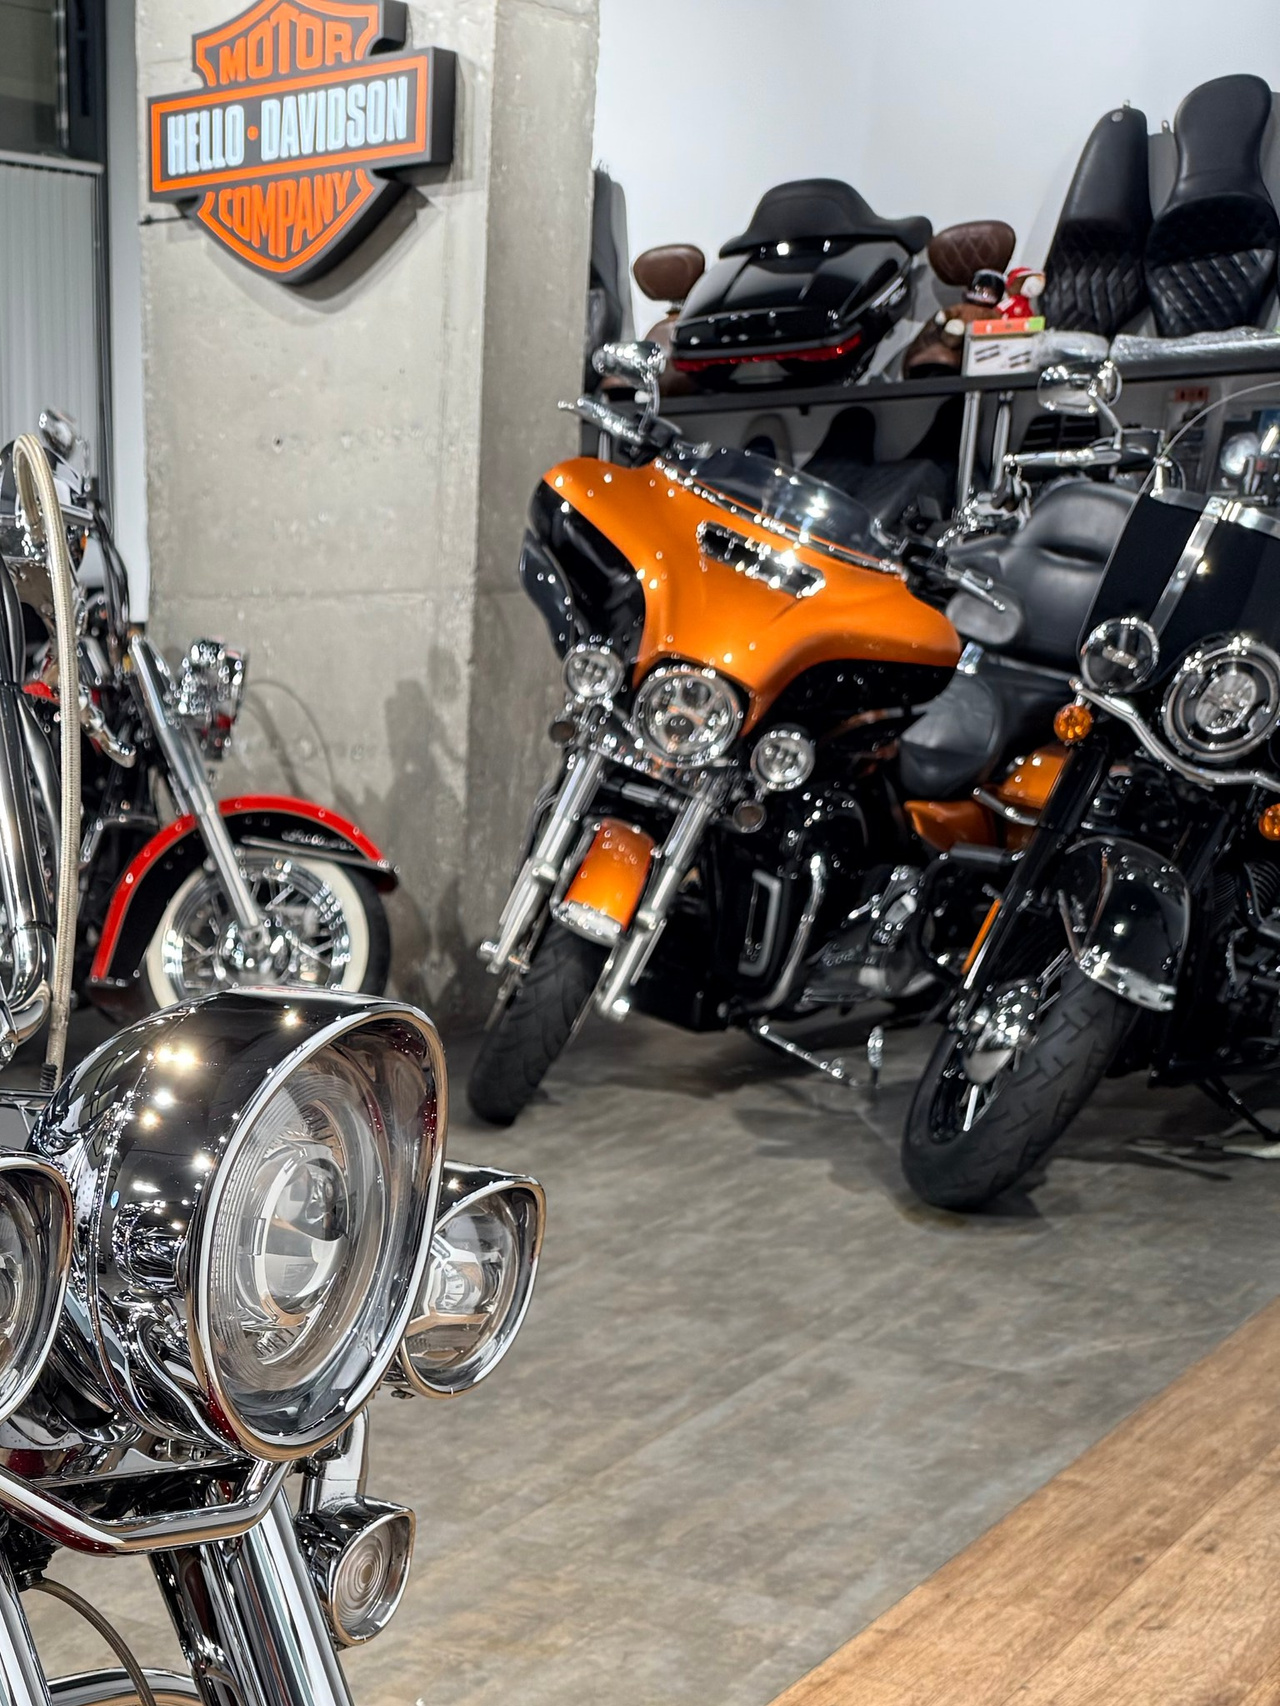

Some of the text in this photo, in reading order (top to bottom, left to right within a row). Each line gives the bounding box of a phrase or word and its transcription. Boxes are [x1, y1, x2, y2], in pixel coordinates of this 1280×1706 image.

[219, 3, 353, 84] MOTOR
[167, 76, 408, 176] HELLO DAVIDSON
[218, 170, 352, 258] COMPANY
